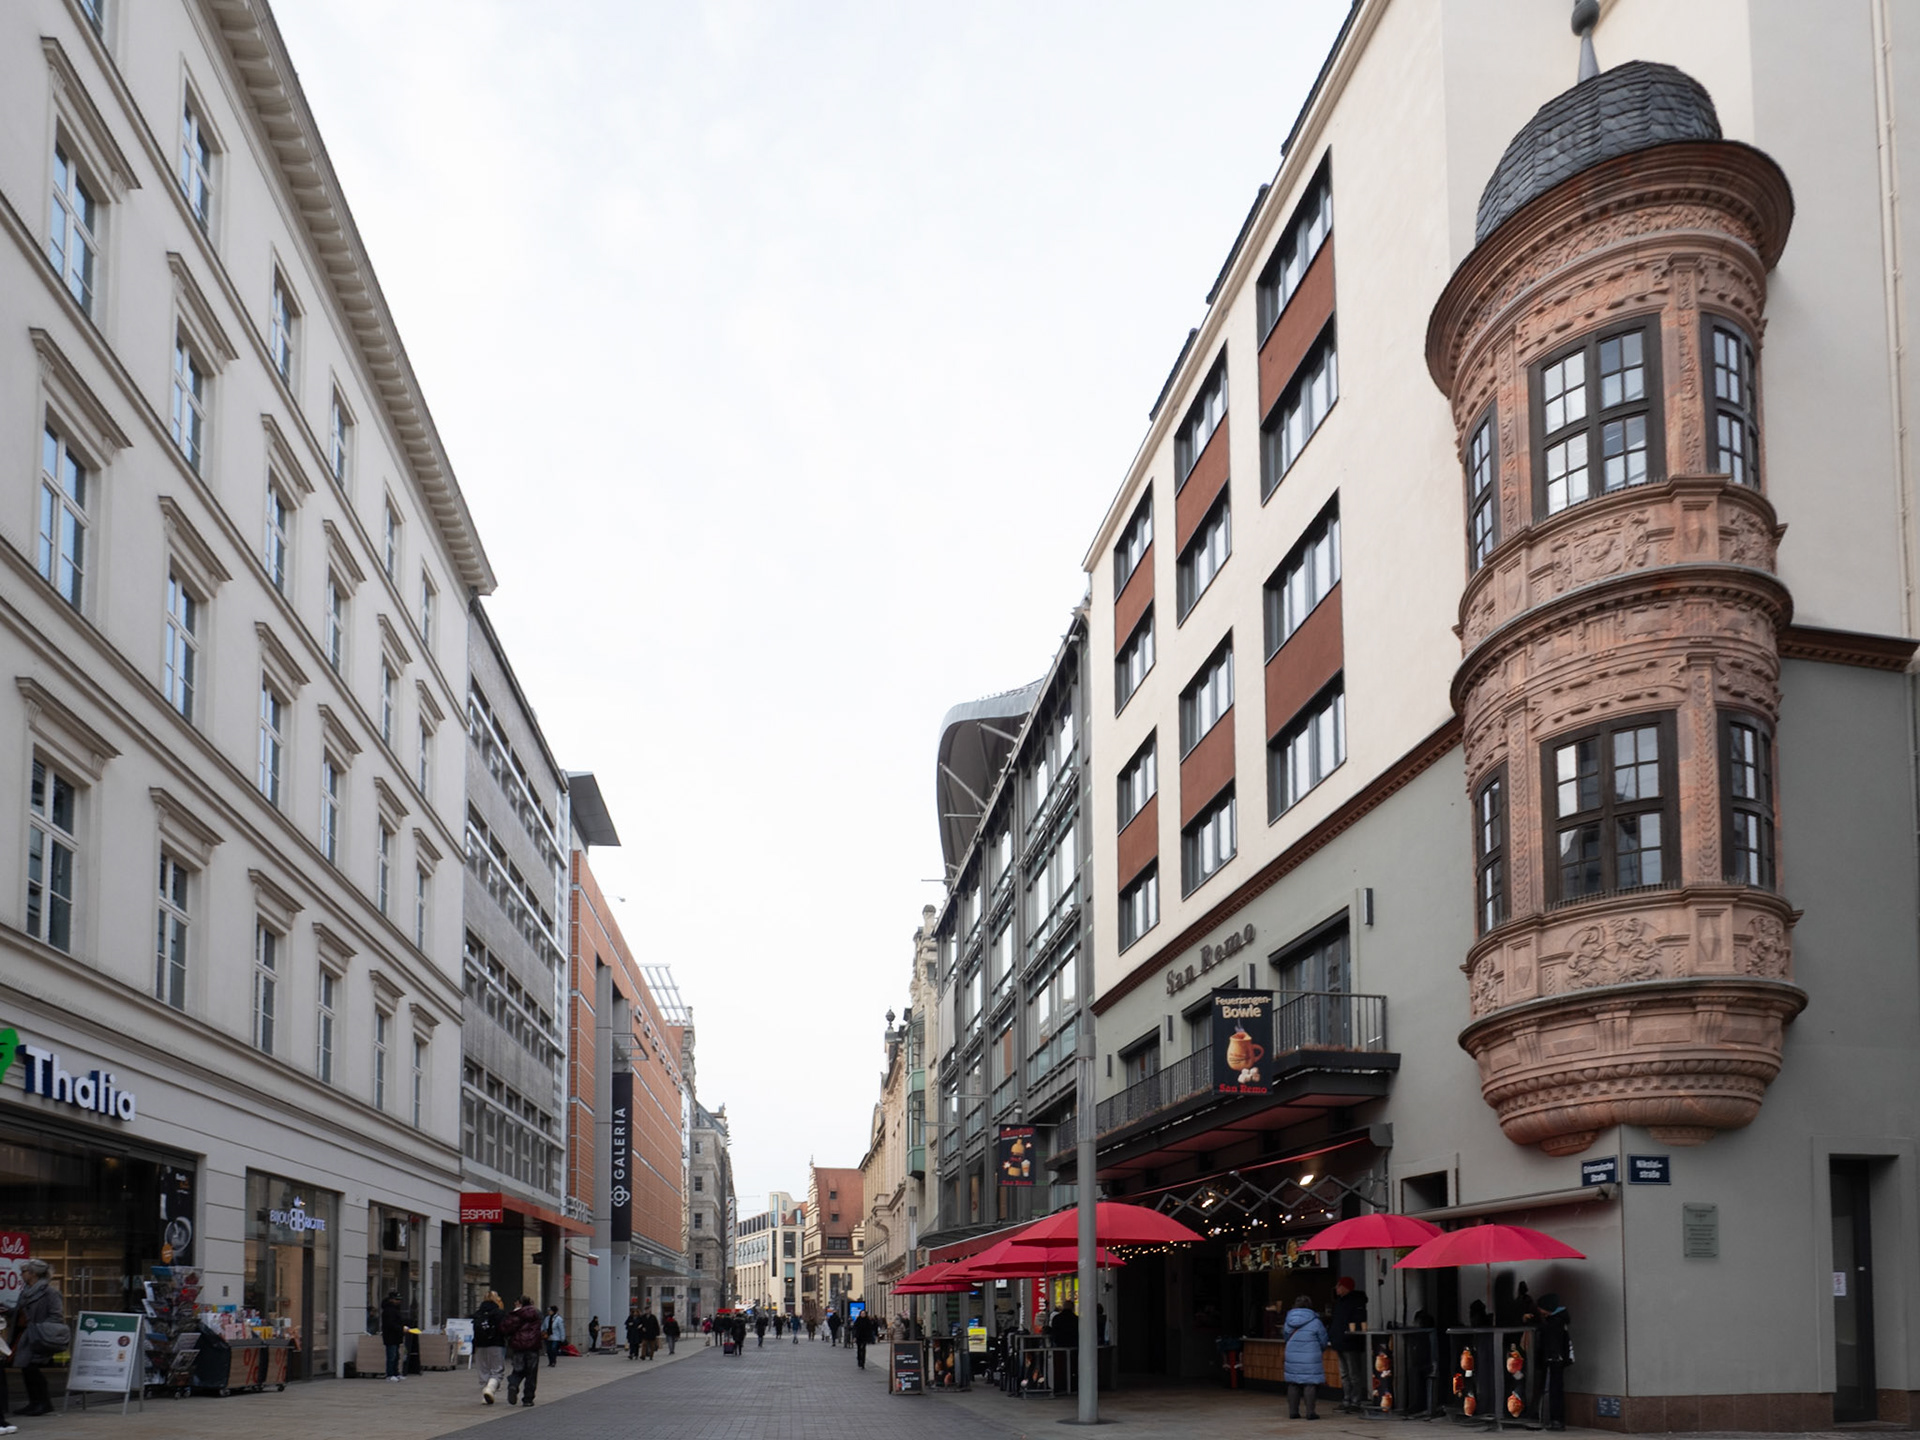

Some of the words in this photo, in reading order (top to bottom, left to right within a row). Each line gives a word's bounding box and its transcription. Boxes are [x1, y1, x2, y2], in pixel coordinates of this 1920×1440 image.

[1166, 964, 1195, 994] San
[1199, 923, 1256, 973] Remo
[1215, 996, 1272, 1006] Feuerzangen-
[1222, 1004, 1262, 1019] Bowle
[24, 1044, 136, 1121] Thalia
[1219, 1083, 1238, 1093] San
[1240, 1084, 1268, 1094] Remo
[614, 1107, 626, 1180] GALERIA
[270, 1209, 290, 1225] BIJOU
[461, 1209, 501, 1220] ESPRIT
[1, 1235, 25, 1255] Sale
